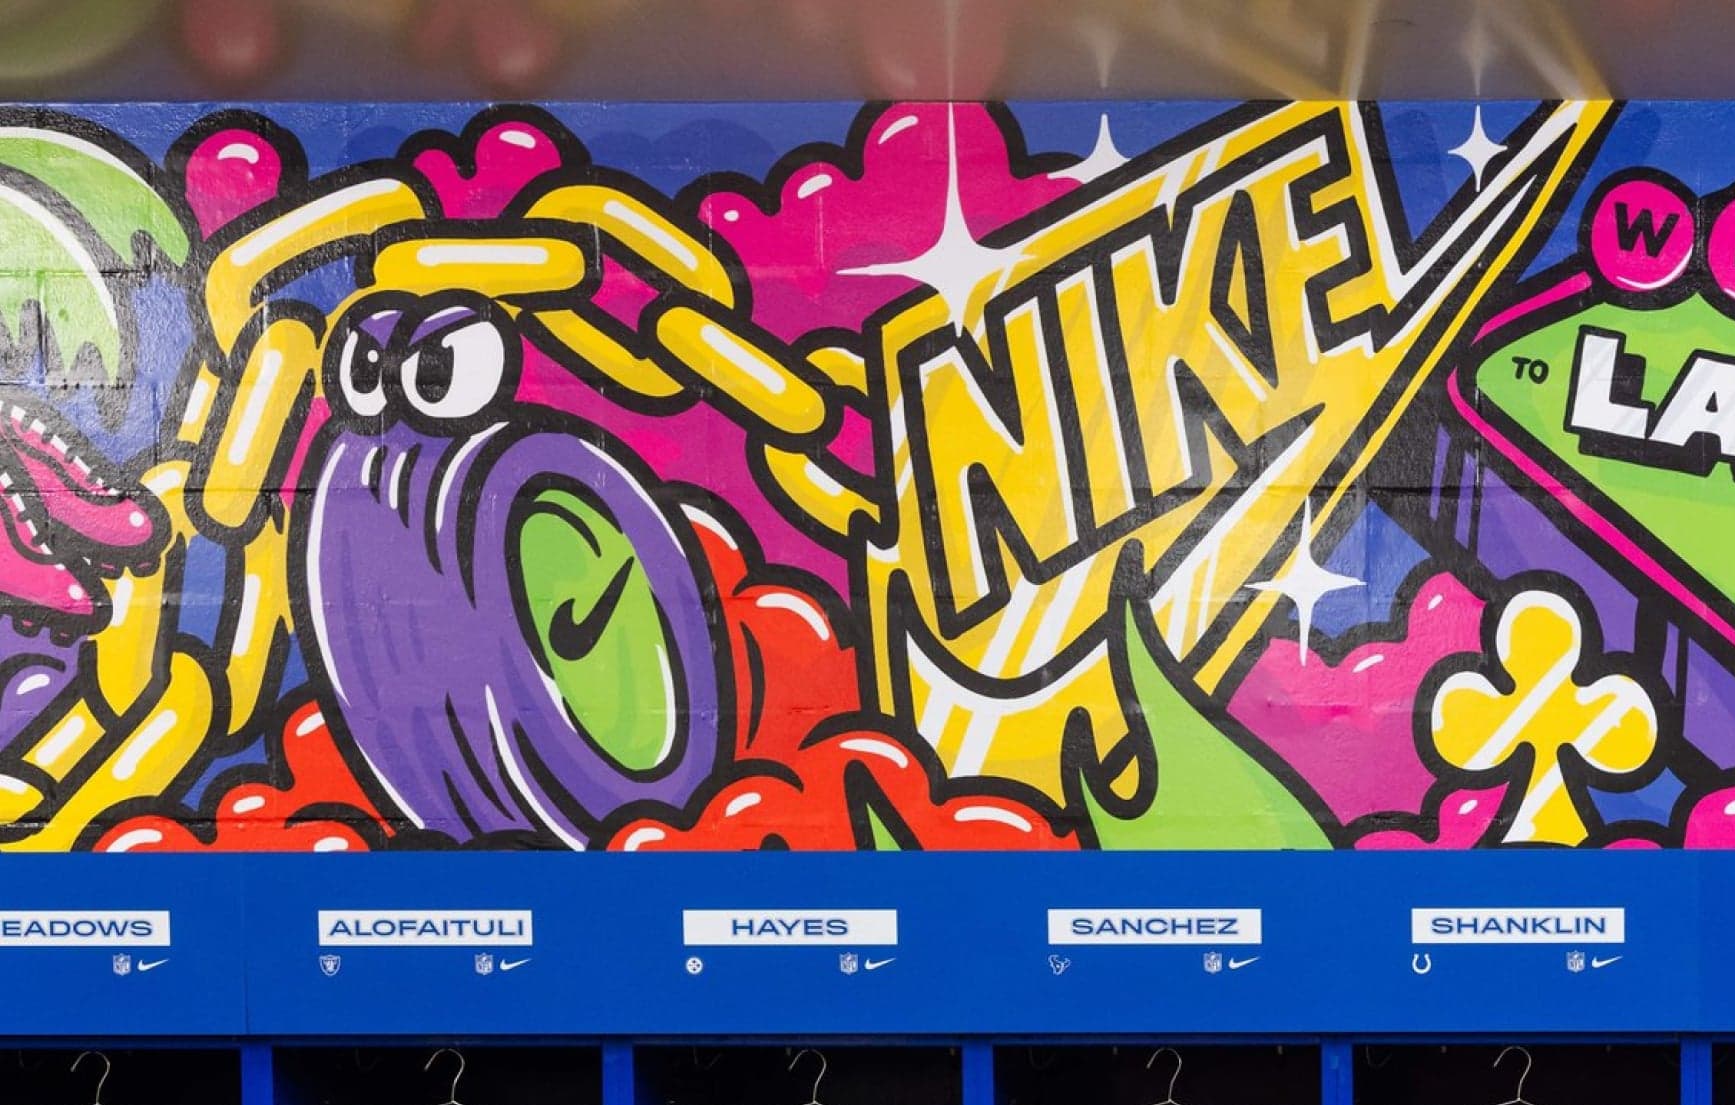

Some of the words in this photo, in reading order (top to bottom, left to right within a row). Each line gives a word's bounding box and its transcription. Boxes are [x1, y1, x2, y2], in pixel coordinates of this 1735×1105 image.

[900, 106, 1386, 640] NIKE
[1511, 355, 1549, 385] TO
[328, 919, 525, 937] ALOFAITULI
[731, 918, 849, 936] HAYES
[1071, 917, 1239, 936] SANCHEZ
[1431, 916, 1606, 935] SHANKLIN
